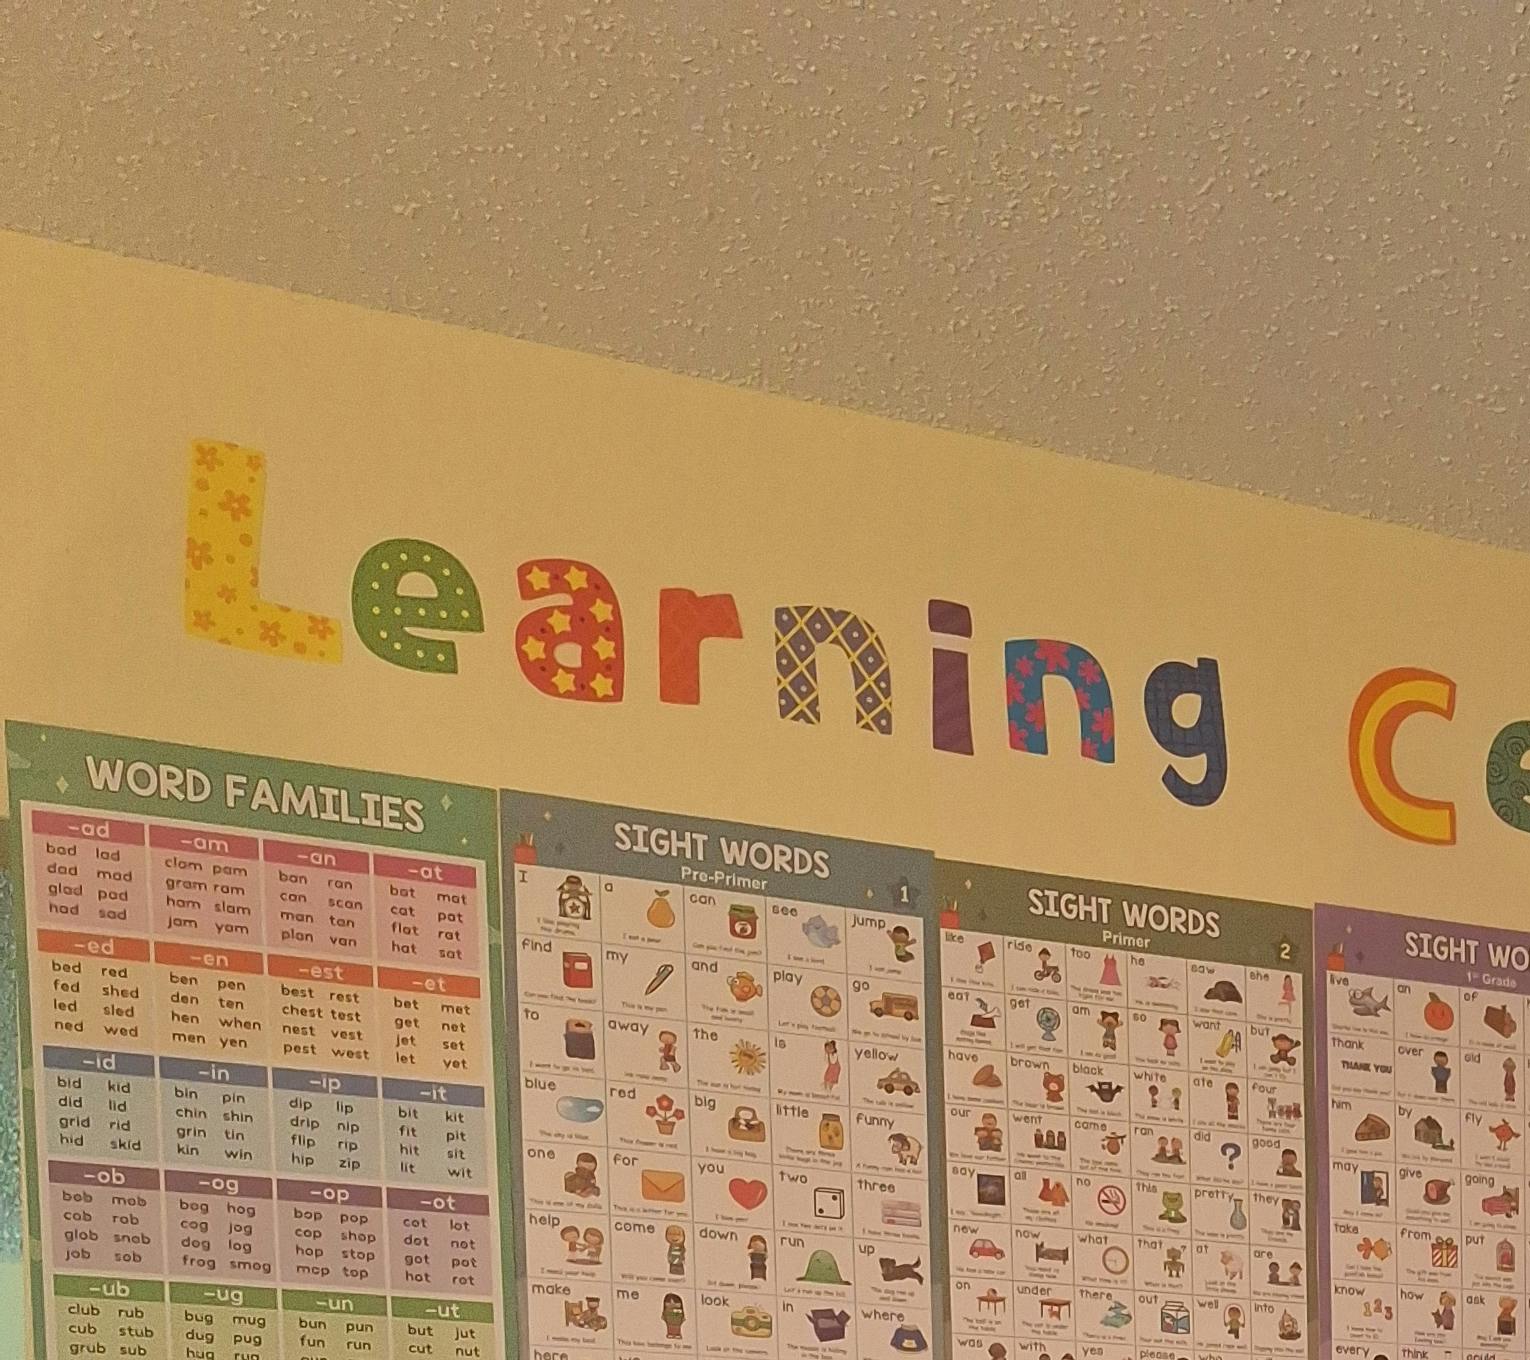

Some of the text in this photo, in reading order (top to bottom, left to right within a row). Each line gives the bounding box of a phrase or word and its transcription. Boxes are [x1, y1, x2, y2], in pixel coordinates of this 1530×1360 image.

[185, 437, 1229, 807] Learning
[85, 755, 425, 833] WORD FAMILIES
[614, 822, 830, 878] SIGHT WORDS
[681, 866, 768, 890] Pre-Primer
[1028, 888, 1220, 938] SIGHT WORDS
[1102, 930, 1151, 948] Primer
[1405, 931, 1480, 965] SIGHT
[773, 969, 803, 986] play
[219, 1017, 262, 1032] when
[1331, 1037, 1364, 1050] thank
[854, 1047, 899, 1062] yellow
[1010, 1057, 1050, 1070] brown
[1072, 1063, 1104, 1076] black
[857, 1179, 896, 1194] three
[229, 1258, 271, 1274] smog
[232, 1314, 266, 1329] mug
[862, 1309, 905, 1323] where
